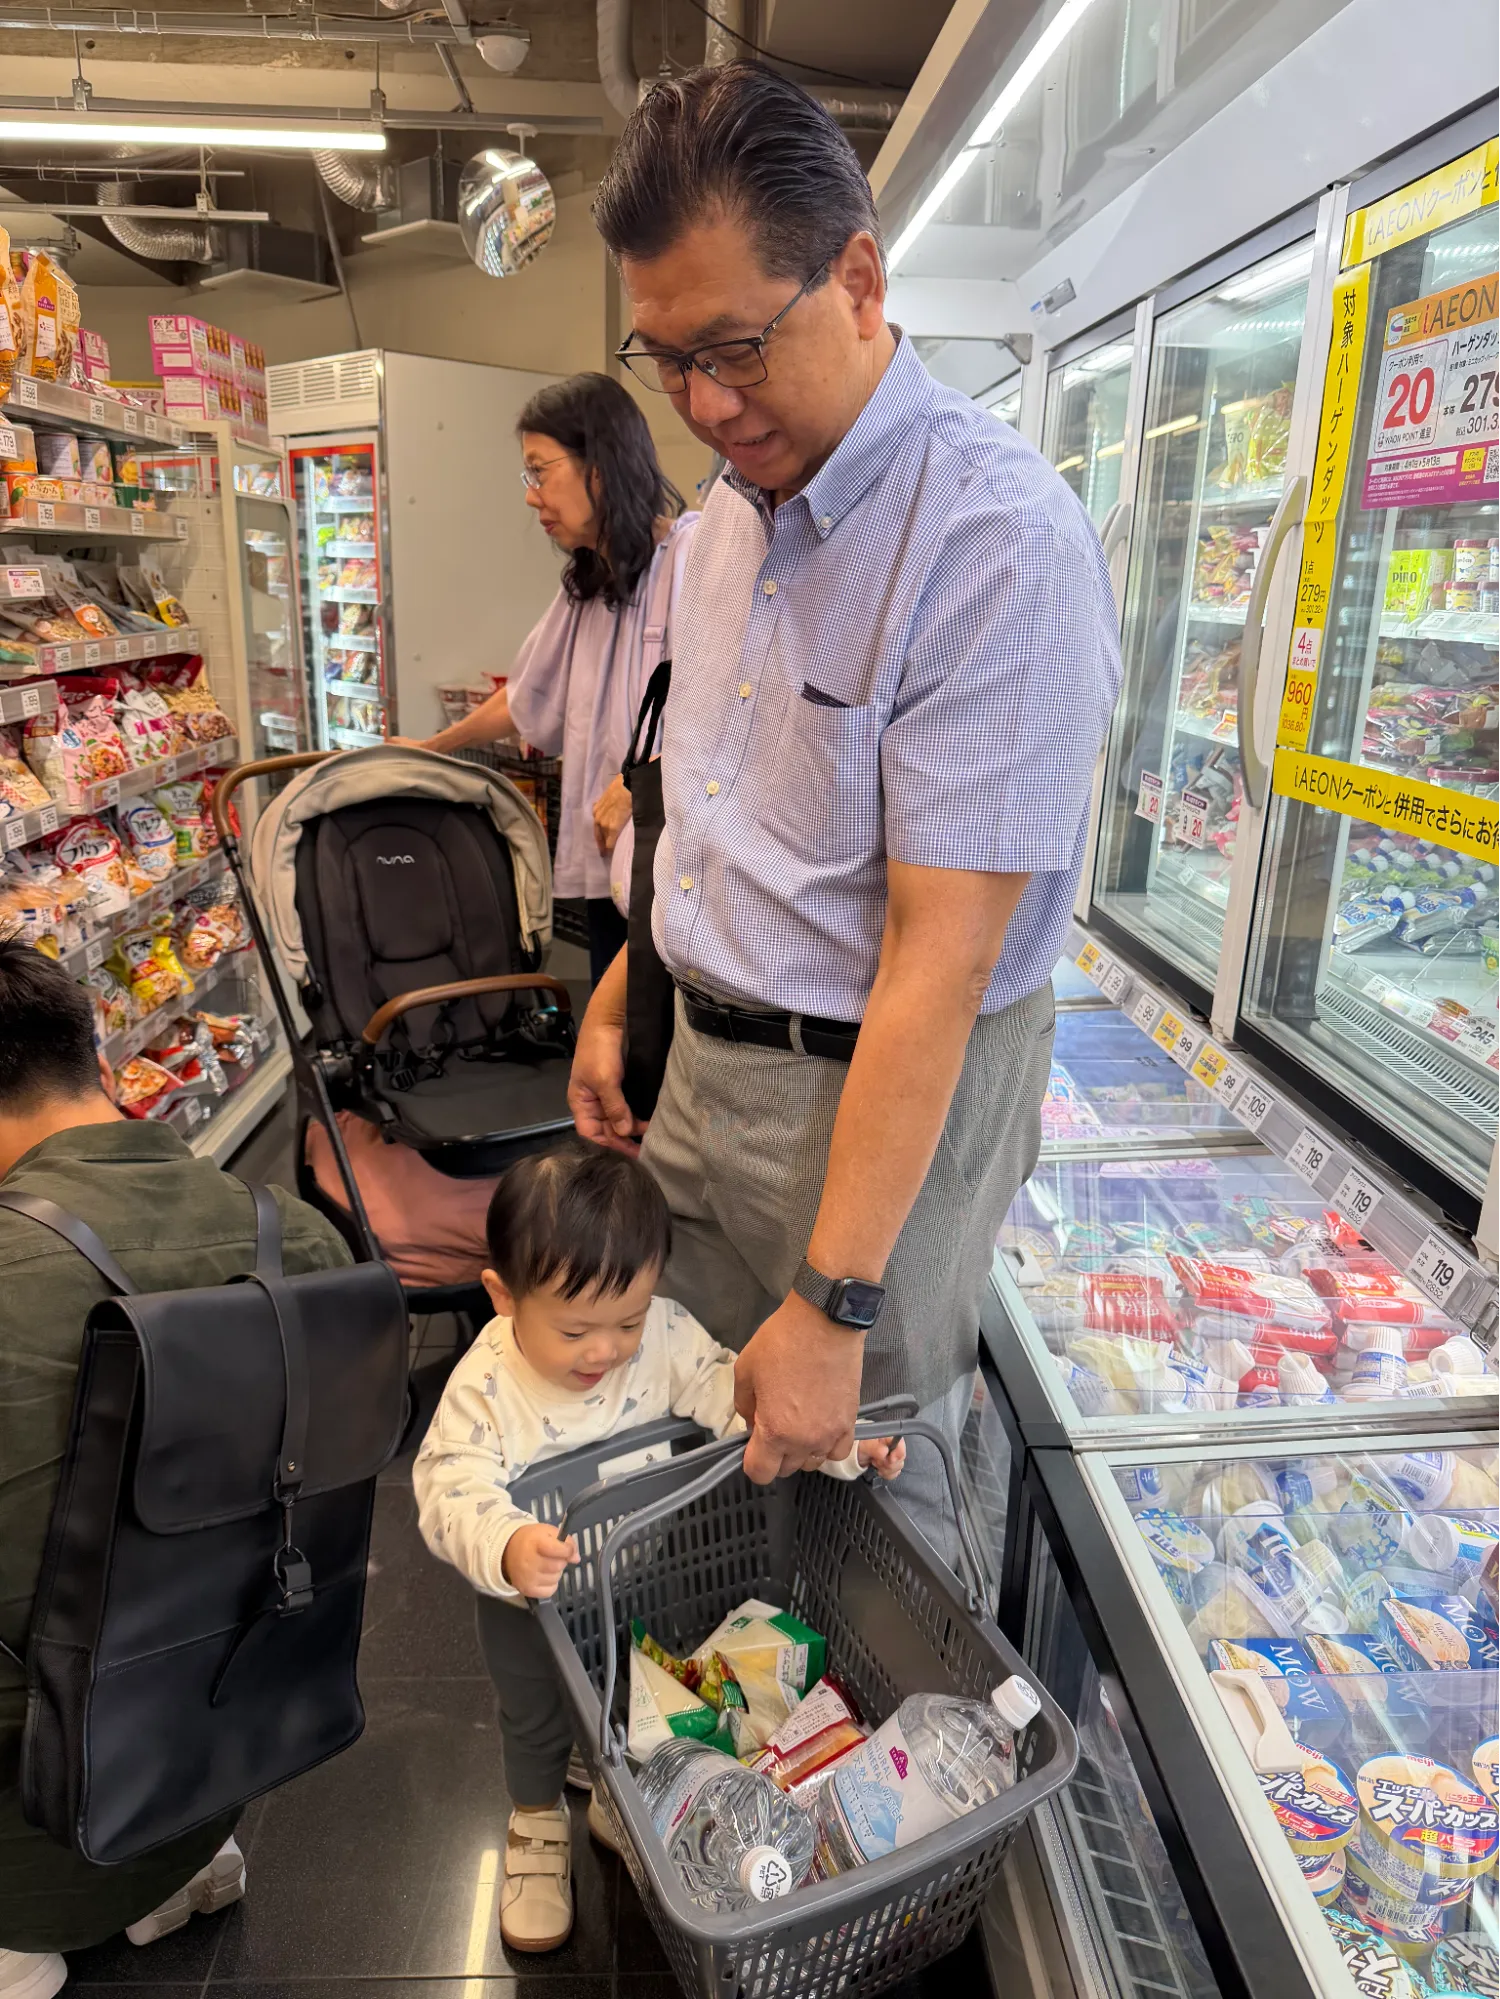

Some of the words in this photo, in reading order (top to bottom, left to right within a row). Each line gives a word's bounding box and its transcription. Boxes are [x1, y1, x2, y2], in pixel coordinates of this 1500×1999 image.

[1367, 160, 1500, 246] iAEONクーポンと
[1452, 330, 1500, 356] ハーゲンダッ
[1383, 367, 1435, 430] 20
[1467, 412, 1500, 434] 301.3
[1298, 632, 1313, 655] 4点
[1287, 681, 1312, 706] 960
[1149, 796, 1159, 814] 20
[1191, 819, 1202, 838] 20
[376, 855, 415, 865] nuna
[1179, 1037, 1193, 1052] 99
[1223, 1075, 1236, 1089] 99
[1248, 1096, 1266, 1118] 109
[1305, 1147, 1323, 1169] 118
[1352, 1189, 1372, 1213] 119
[1431, 1259, 1455, 1287] 119
[1270, 1644, 1330, 1714] MOW
[1296, 1743, 1322, 1760] meiji
[1405, 1754, 1434, 1767] meiji
[881, 1785, 905, 1824] WATER
[1256, 1774, 1357, 1824] ーパーカップ
[1371, 1793, 1499, 1830] スーパーカップ
[1421, 1829, 1438, 1843] 超
[1440, 1834, 1476, 1848] バニラ
